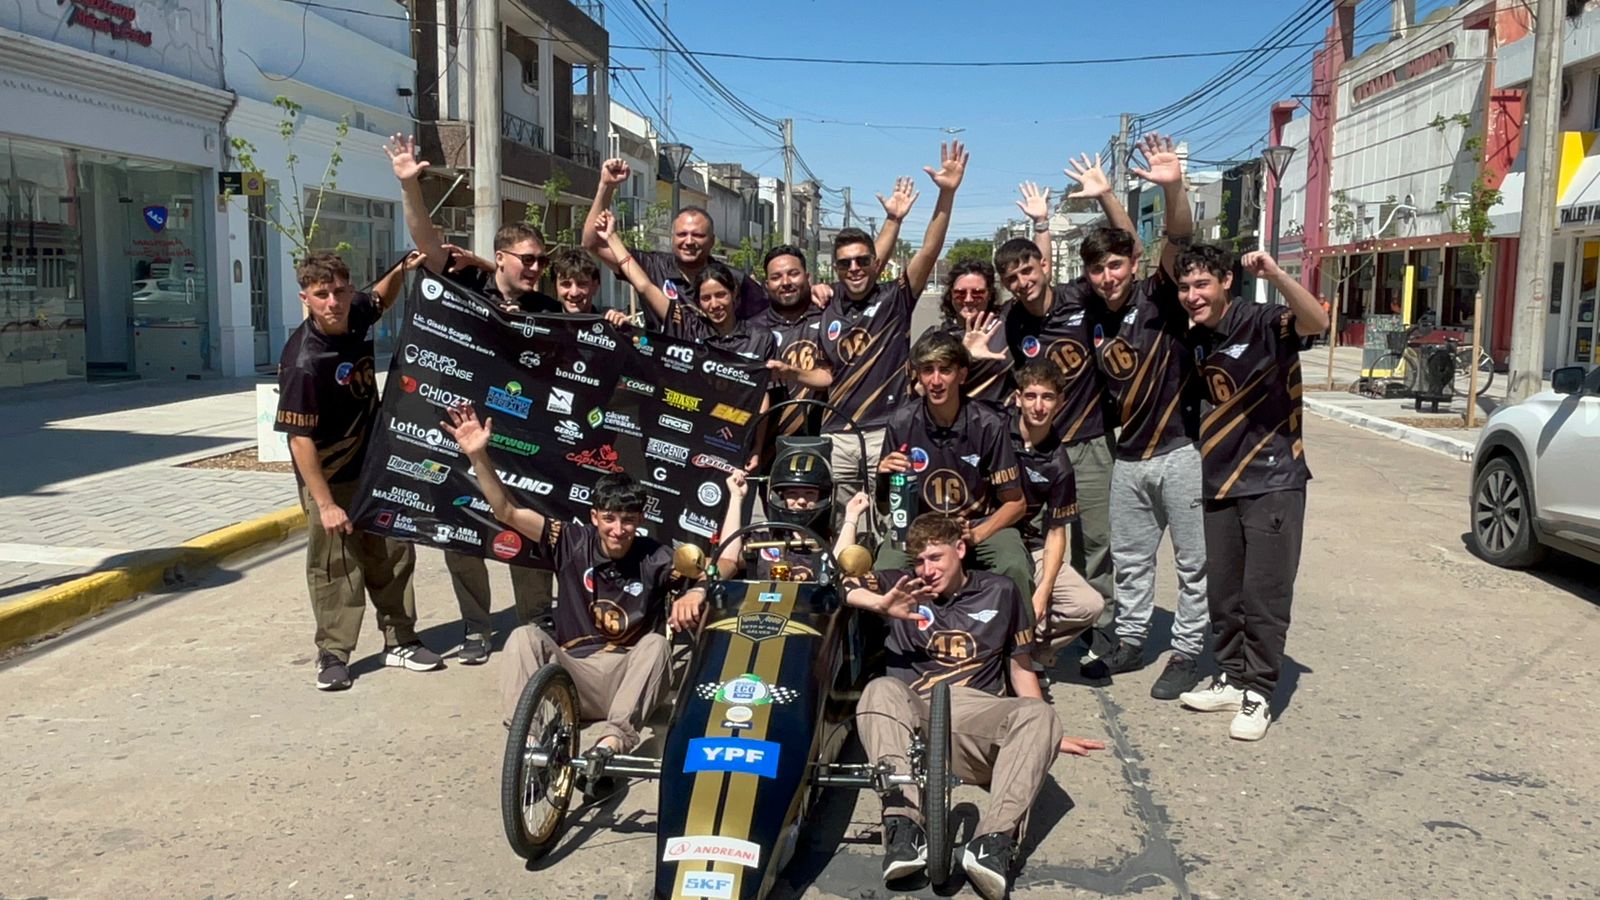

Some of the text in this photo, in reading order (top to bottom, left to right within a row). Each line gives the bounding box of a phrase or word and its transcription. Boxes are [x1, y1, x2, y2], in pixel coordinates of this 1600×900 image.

[426, 318, 448, 333] Gisela
[577, 329, 616, 348] Mariño
[420, 349, 457, 368] GRUPO
[787, 346, 815, 371] 16
[1050, 344, 1082, 374] 16
[1104, 342, 1133, 375] 16
[418, 358, 474, 382] GALVENSE
[555, 367, 600, 386] bounous
[627, 380, 655, 393] COGAS
[390, 417, 426, 438] Lotto
[442, 437, 463, 451] Hno
[491, 432, 540, 455] erweny
[372, 488, 435, 513] MAZZUCHELLI
[391, 486, 420, 501] DIEGO
[931, 477, 961, 505] 16
[594, 607, 620, 635] 16
[933, 635, 967, 659] 16
[733, 685, 756, 694] ECO
[702, 747, 765, 763] YPF
[693, 845, 756, 861] ANDREANI
[684, 878, 731, 890] SKF
